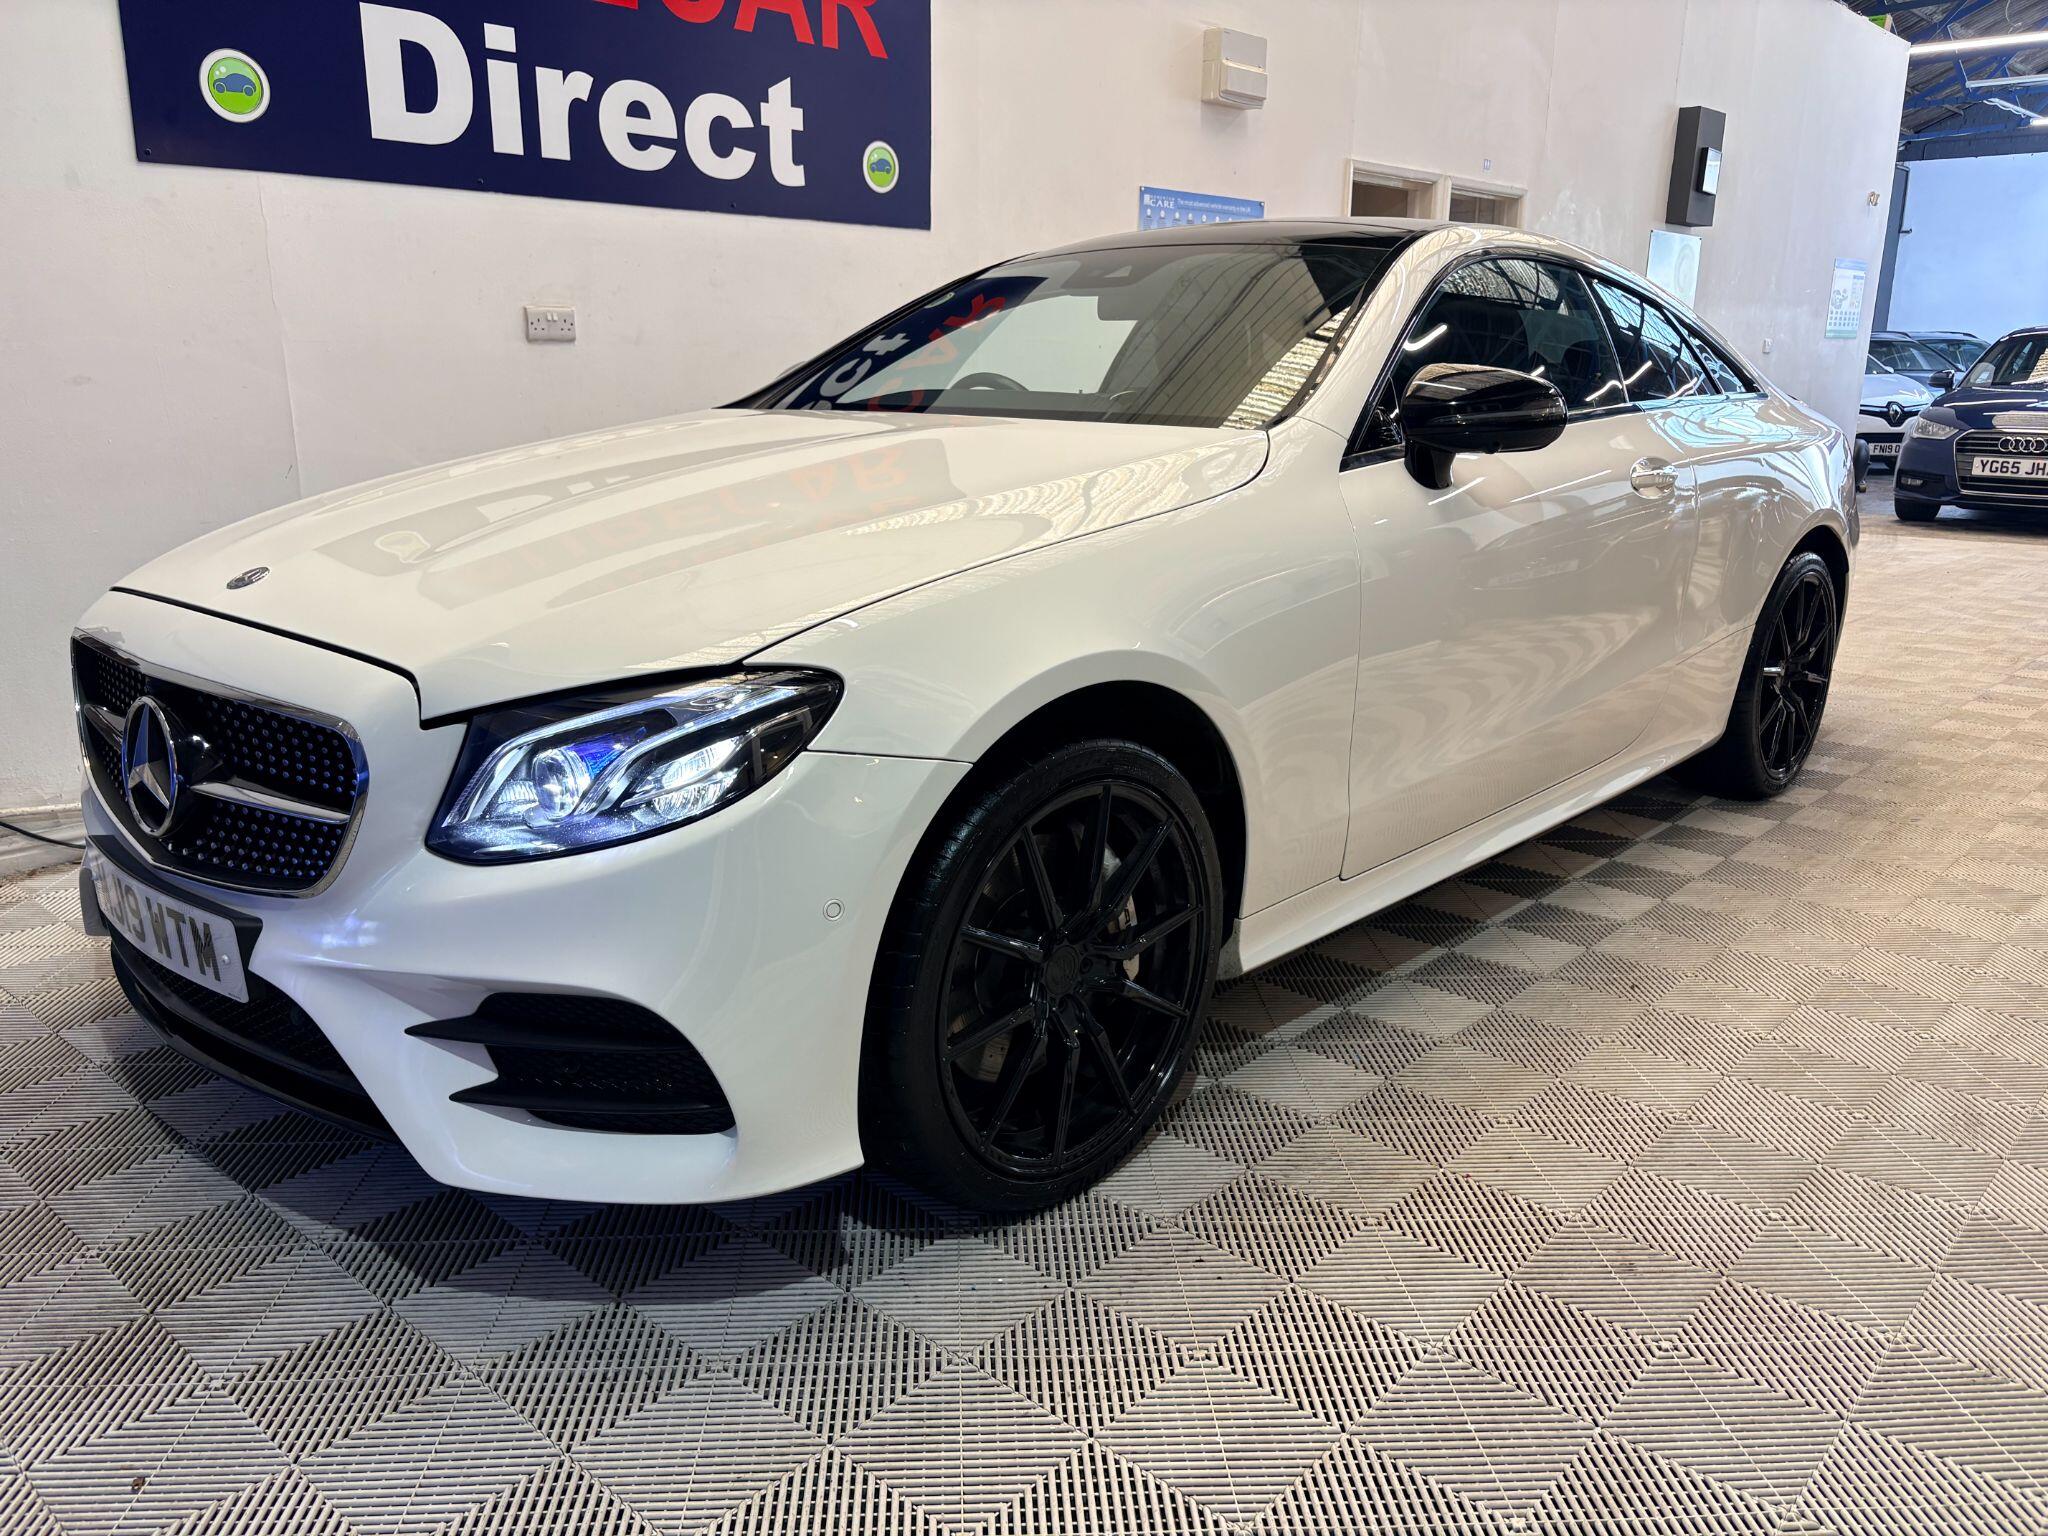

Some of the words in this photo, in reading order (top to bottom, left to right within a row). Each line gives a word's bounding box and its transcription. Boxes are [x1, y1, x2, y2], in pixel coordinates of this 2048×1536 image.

[359, 1, 806, 188] Direct
[1150, 199, 1175, 209] CARE
[1872, 444, 1894, 454] FN19
[1980, 459, 2022, 475] YG65
[2024, 462, 2048, 477] JH
[145, 896, 222, 983] WTM
